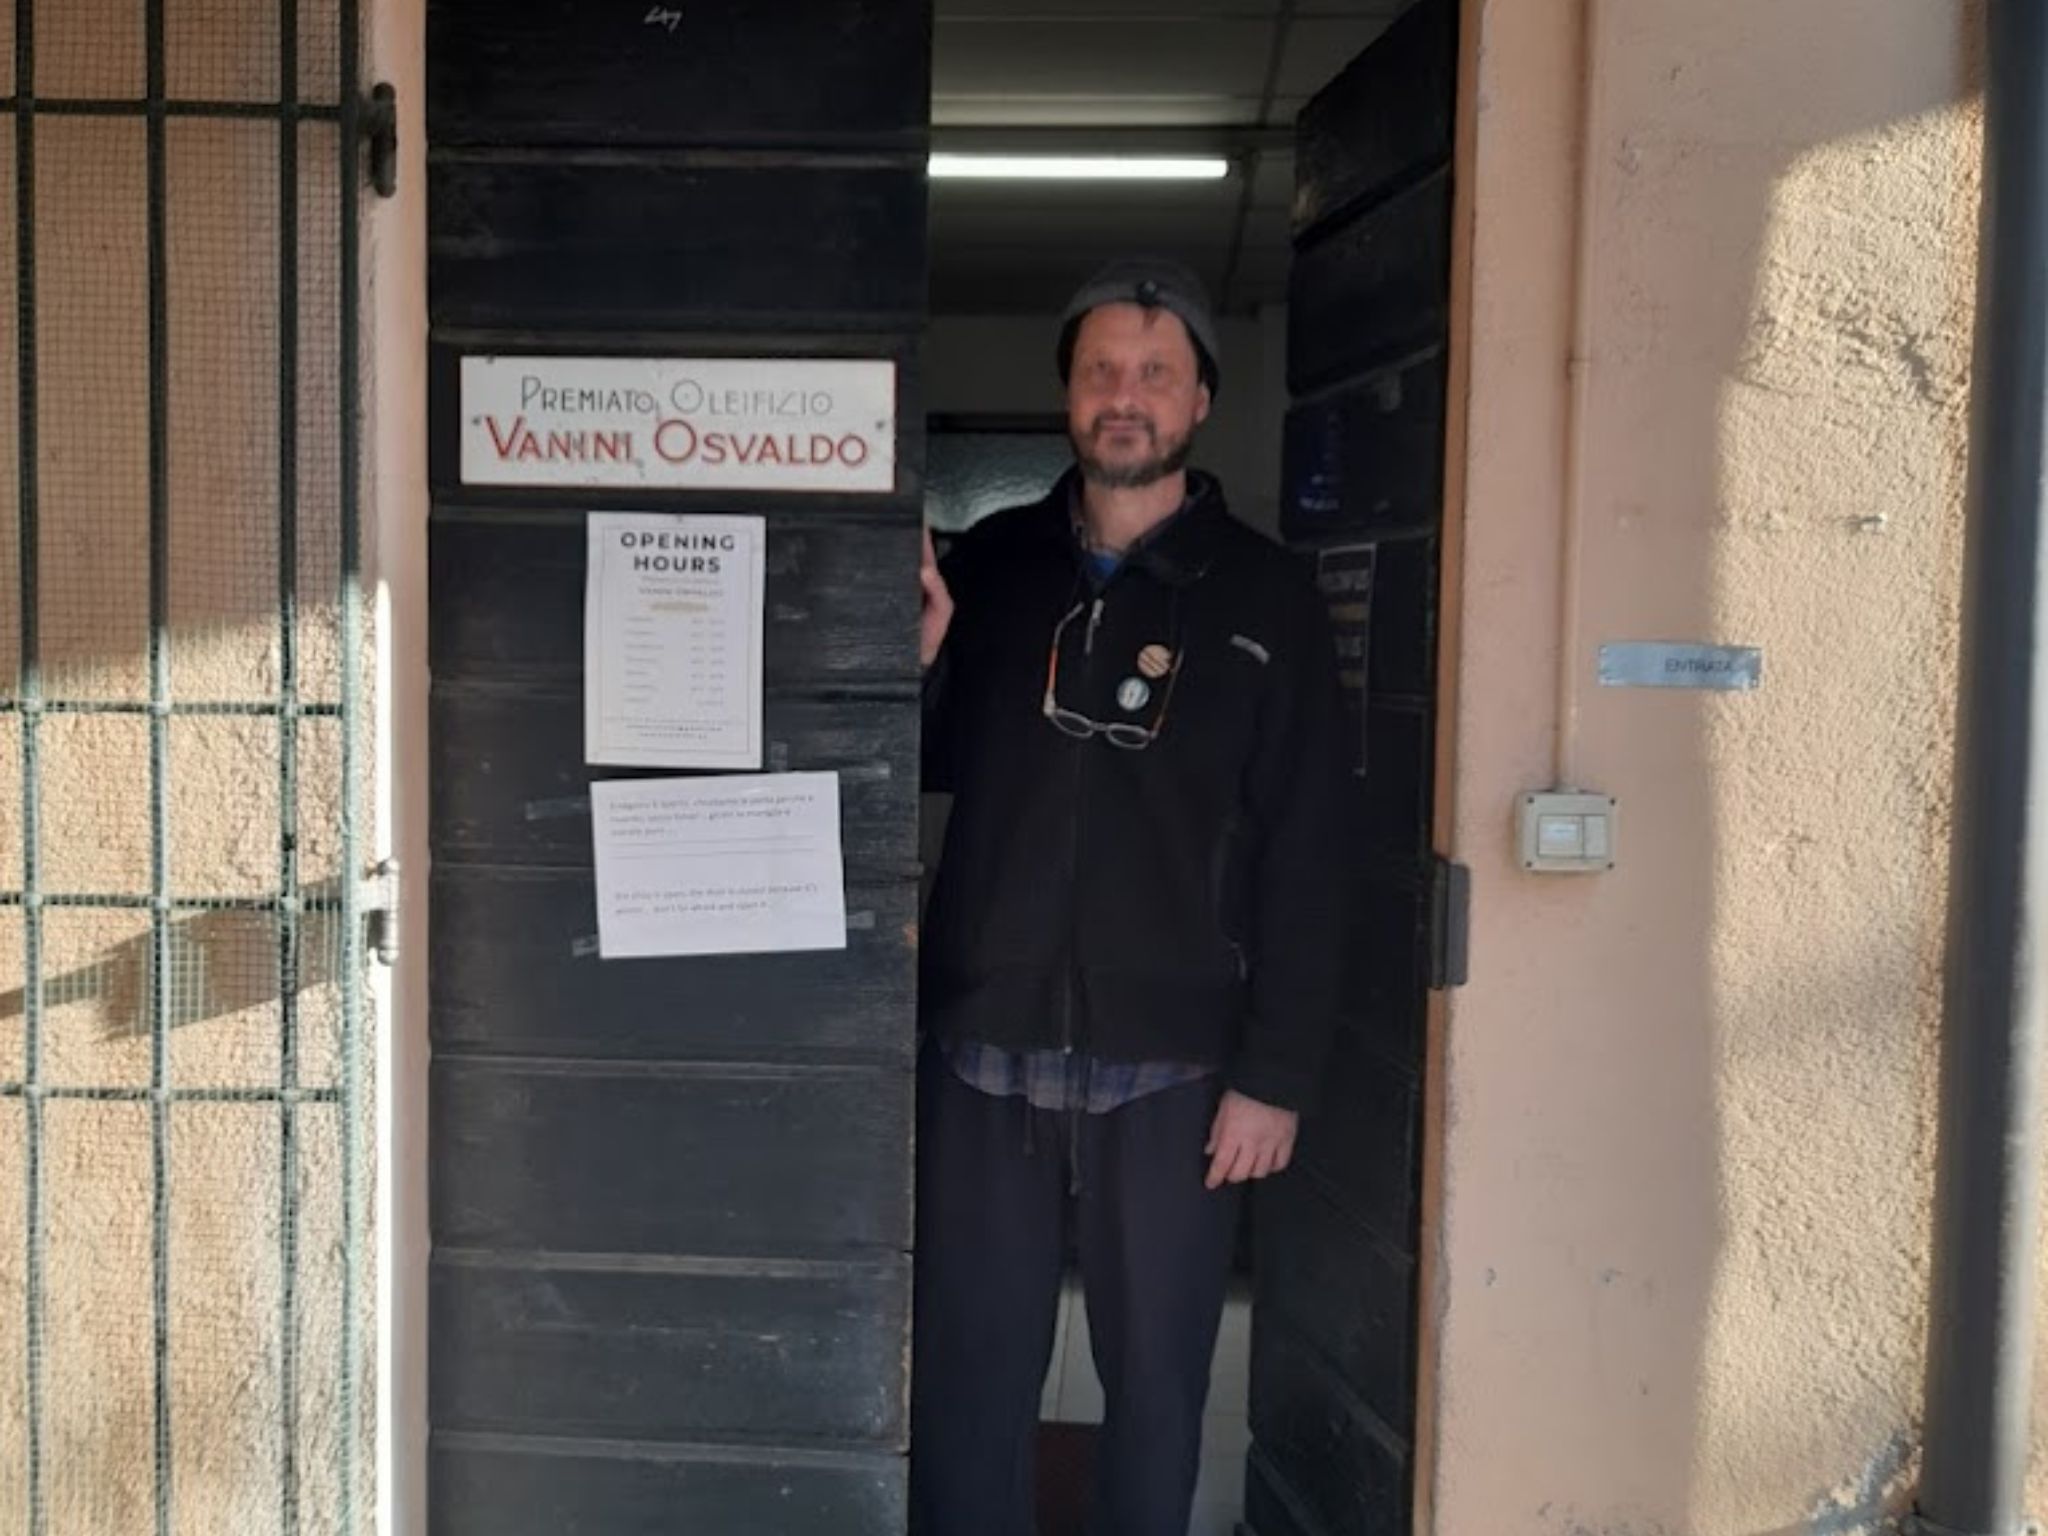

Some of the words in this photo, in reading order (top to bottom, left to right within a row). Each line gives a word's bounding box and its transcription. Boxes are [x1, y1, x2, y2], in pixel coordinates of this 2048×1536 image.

[520, 375, 656, 414] PREMIATO
[670, 378, 833, 416] OLEIFIZIO
[485, 415, 635, 462] VANINI
[654, 418, 868, 467] OSVALDO
[620, 531, 735, 551] OPENING
[633, 555, 721, 573] HOURS
[1664, 657, 1732, 673] ENTRATA
